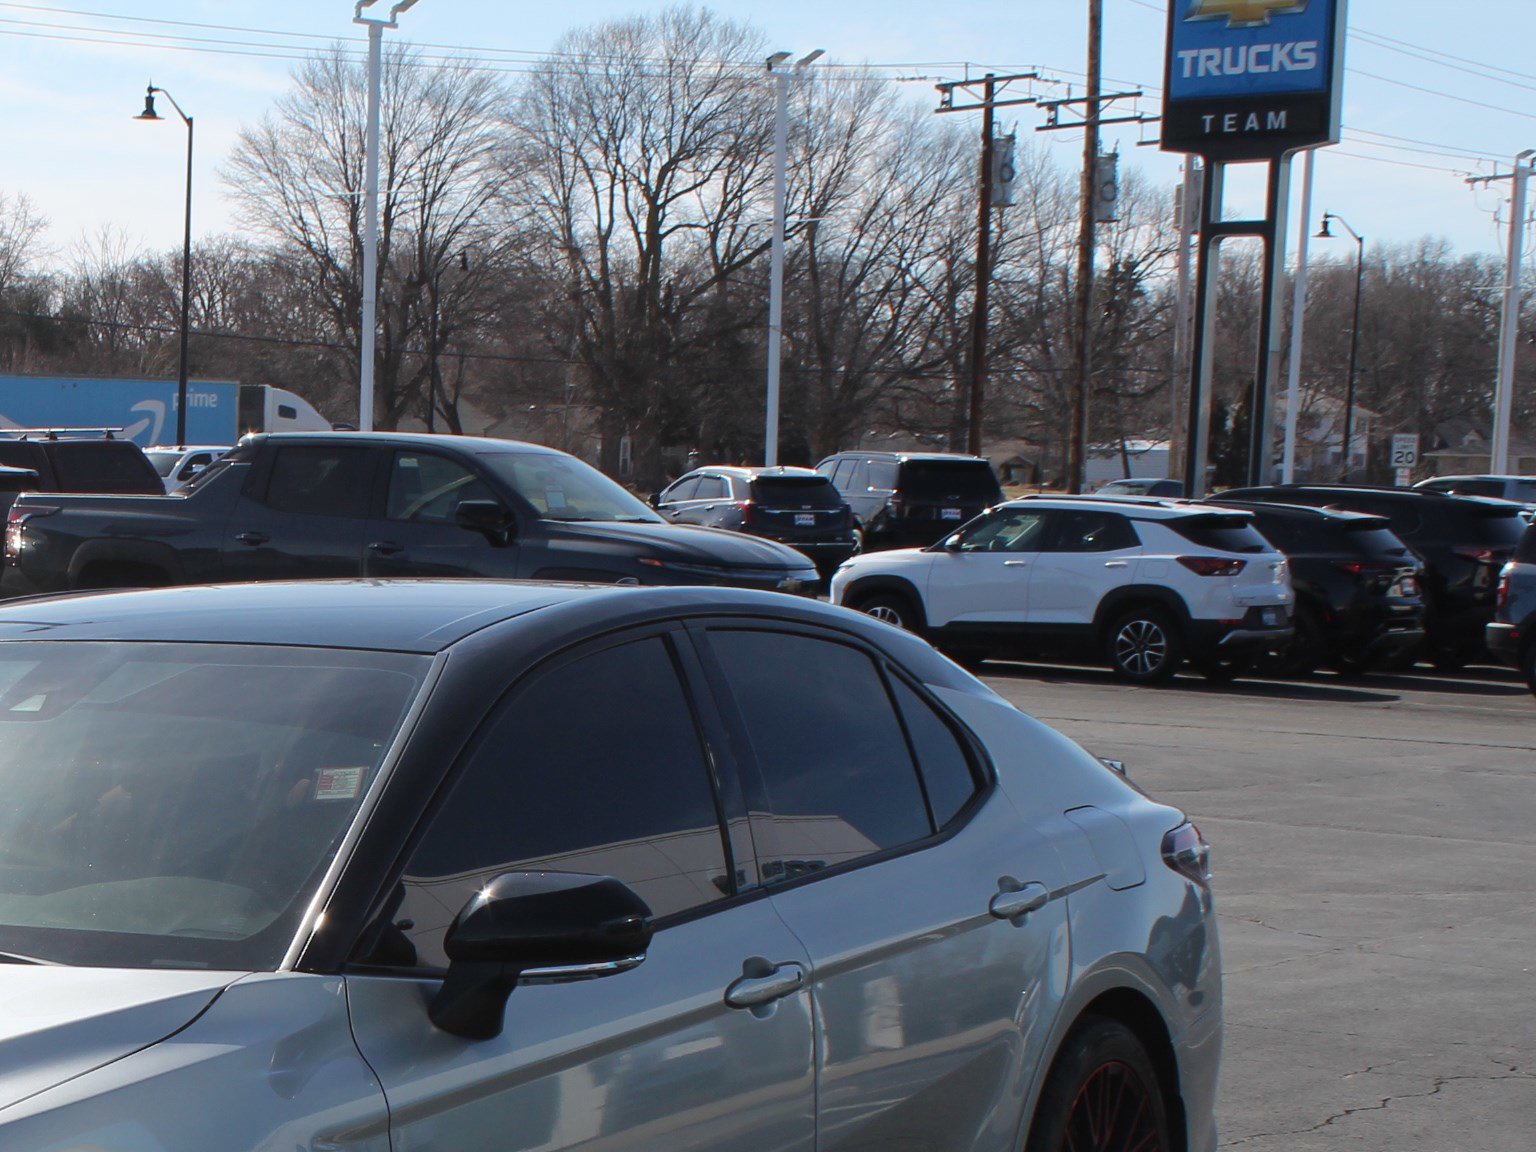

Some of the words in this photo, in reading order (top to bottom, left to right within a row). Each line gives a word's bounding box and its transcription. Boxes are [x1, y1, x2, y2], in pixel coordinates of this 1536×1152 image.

[1177, 40, 1318, 78] TRUCKS
[1202, 110, 1287, 133] TEAM
[1394, 451, 1414, 464] 20
